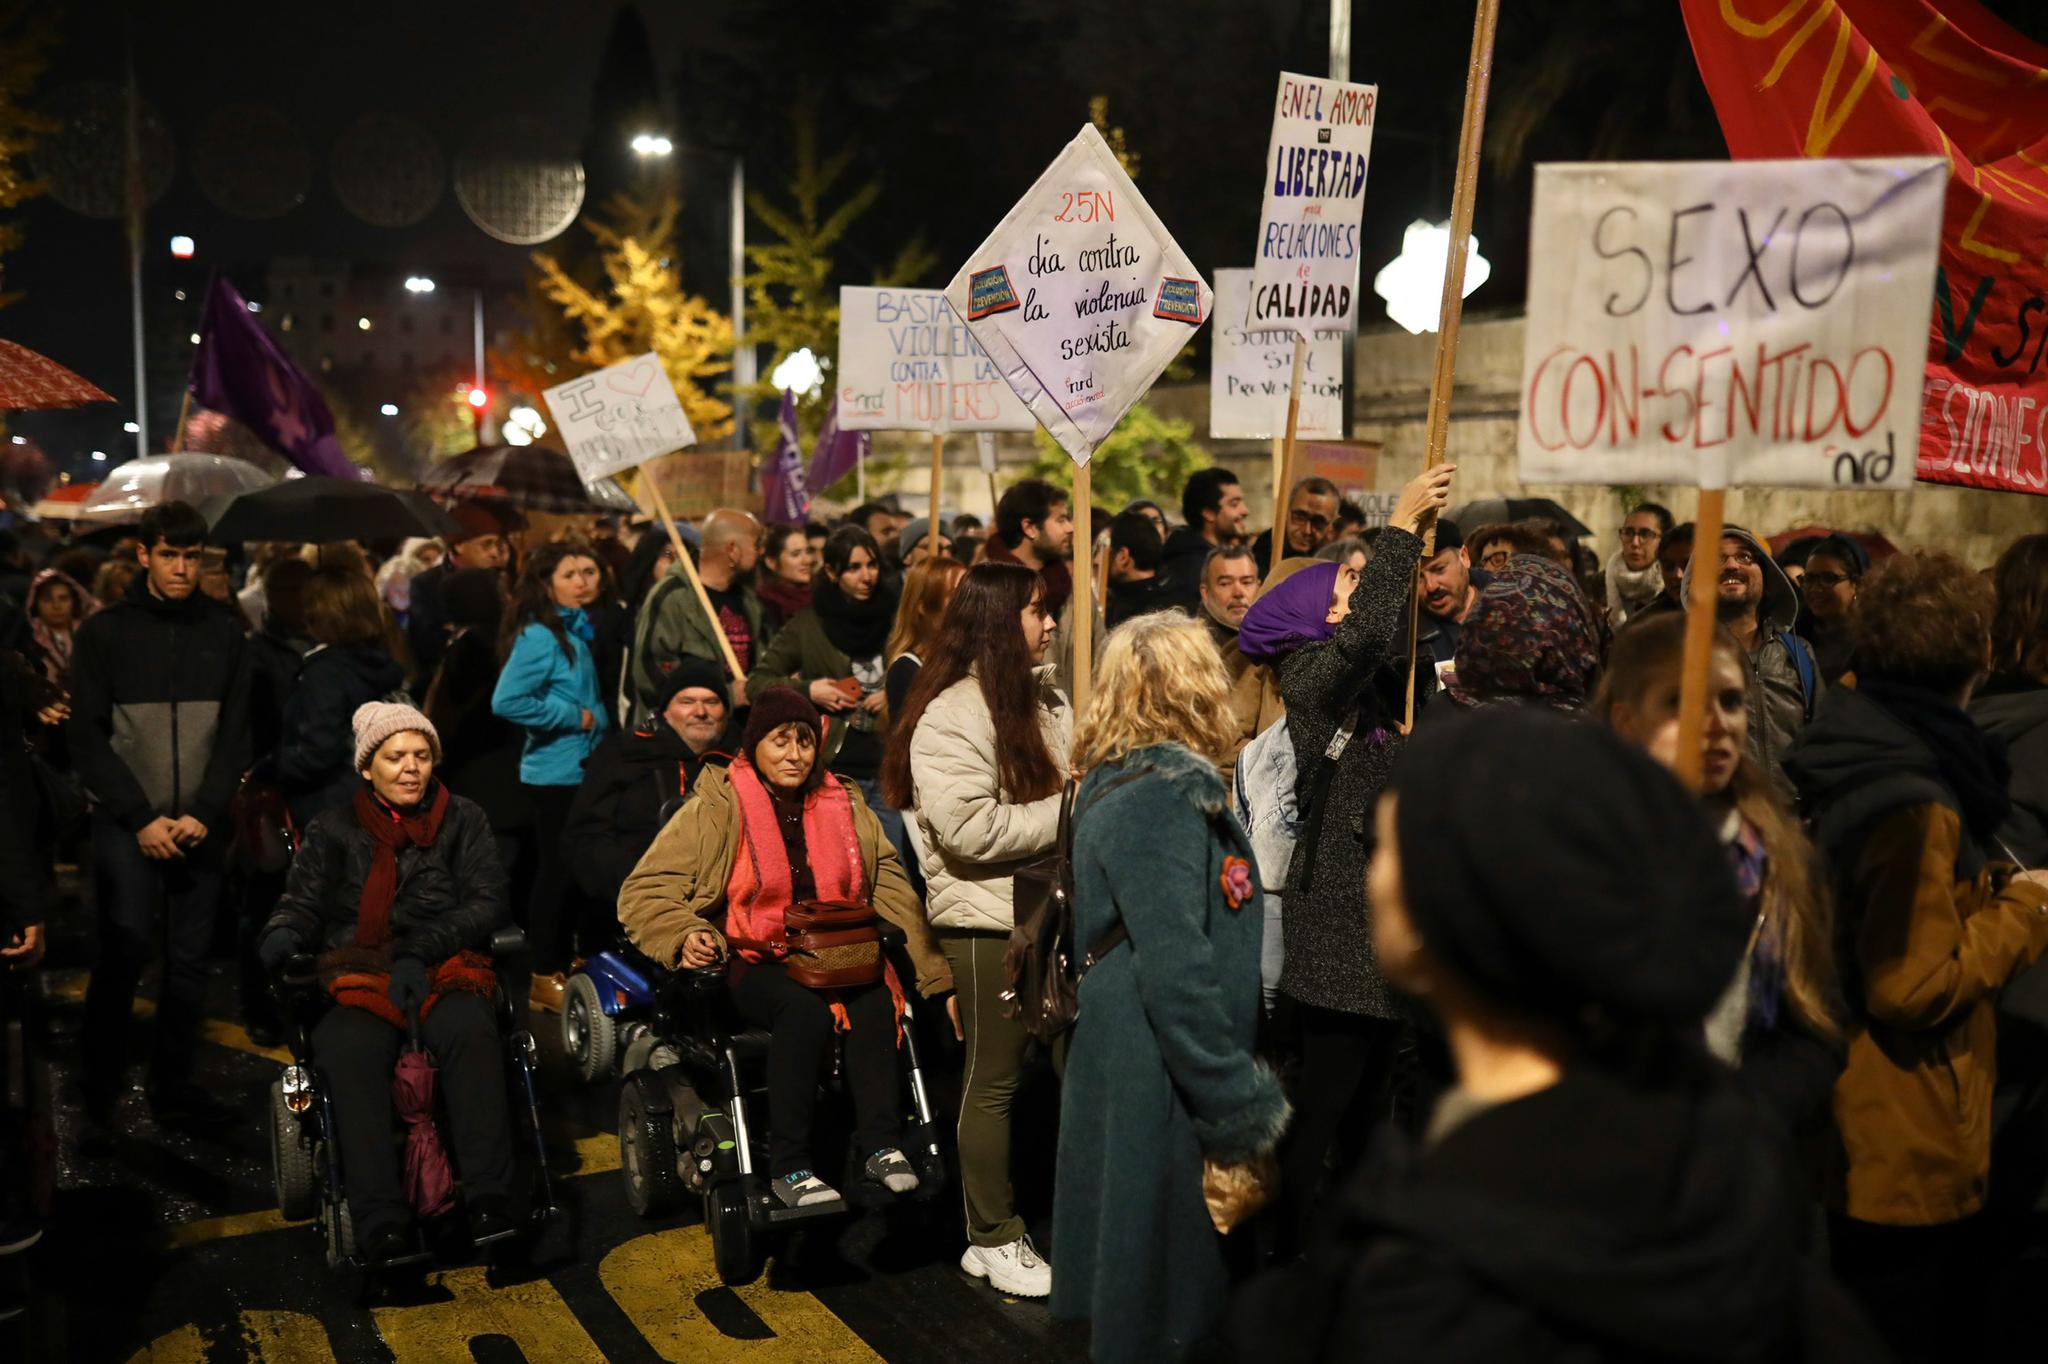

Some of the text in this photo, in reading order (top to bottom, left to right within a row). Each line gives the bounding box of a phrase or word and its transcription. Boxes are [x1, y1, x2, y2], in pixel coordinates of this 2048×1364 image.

[1329, 88, 1374, 126] AMOR
[1274, 145, 1366, 199] LIBERTAD
[1054, 191, 1115, 223] 25N
[1079, 233, 1140, 272] contra
[1263, 222, 1356, 260] RELACIONES
[1592, 202, 1855, 317] SEXO
[1296, 264, 1310, 280] de
[1023, 277, 1147, 322] la violencia
[1061, 320, 1131, 360] sexista
[895, 382, 1000, 421] MUJERES
